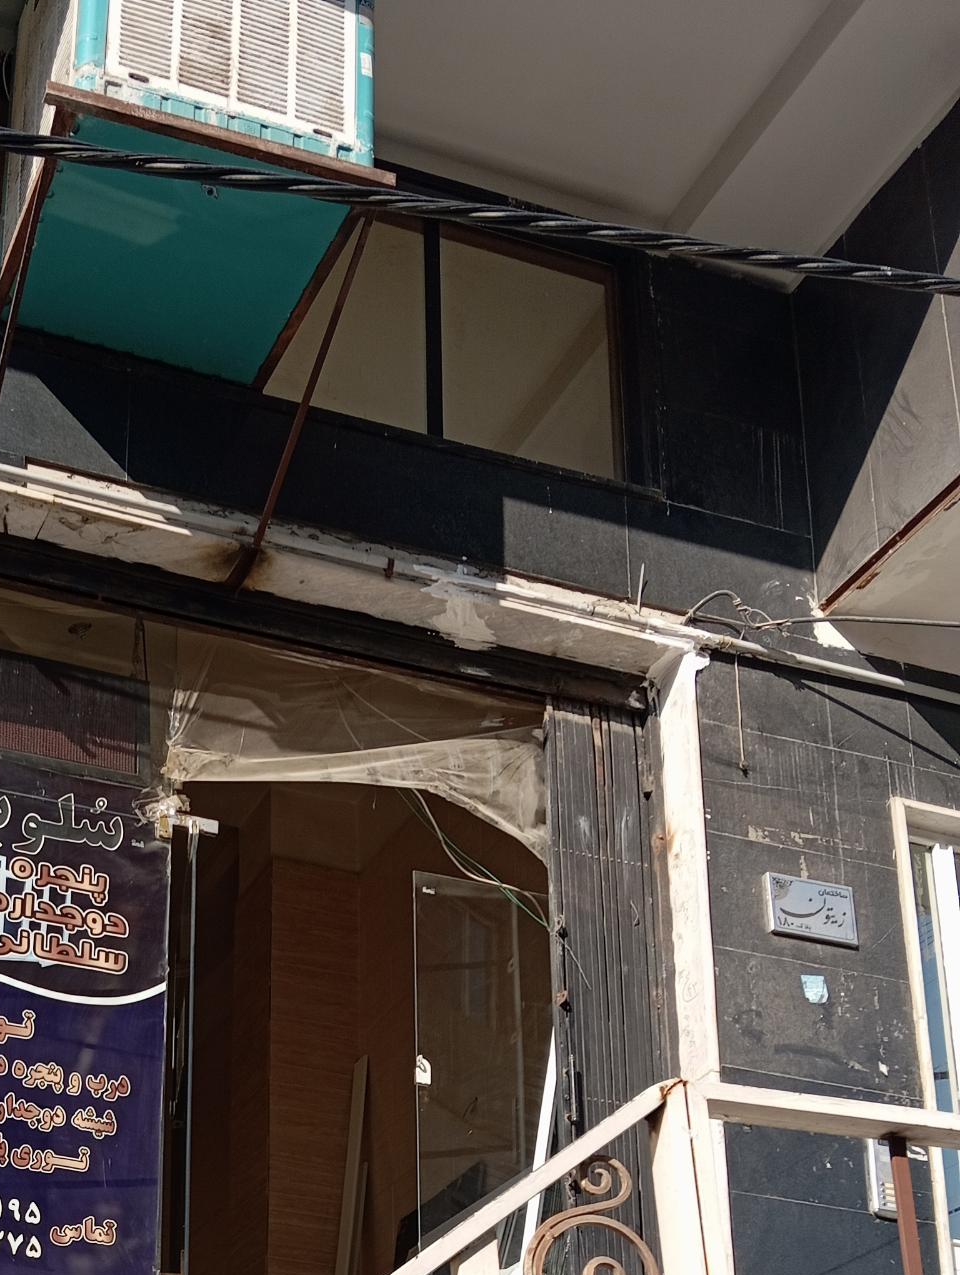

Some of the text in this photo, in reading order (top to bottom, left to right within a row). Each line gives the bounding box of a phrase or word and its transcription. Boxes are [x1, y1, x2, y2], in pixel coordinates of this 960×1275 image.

[10, 856, 109, 905] پنجره
[818, 889, 848, 899] ساختمان
[777, 915, 812, 931] پلاک ۱۸۰
[780, 897, 846, 928] زیتون
[12, 1062, 64, 1093] پنجره
[67, 1071, 81, 1095] و
[86, 1073, 131, 1101] درب
[72, 1106, 118, 1139] شیشه
[11, 1147, 90, 1173] توری
[49, 1215, 118, 1247] تماس
